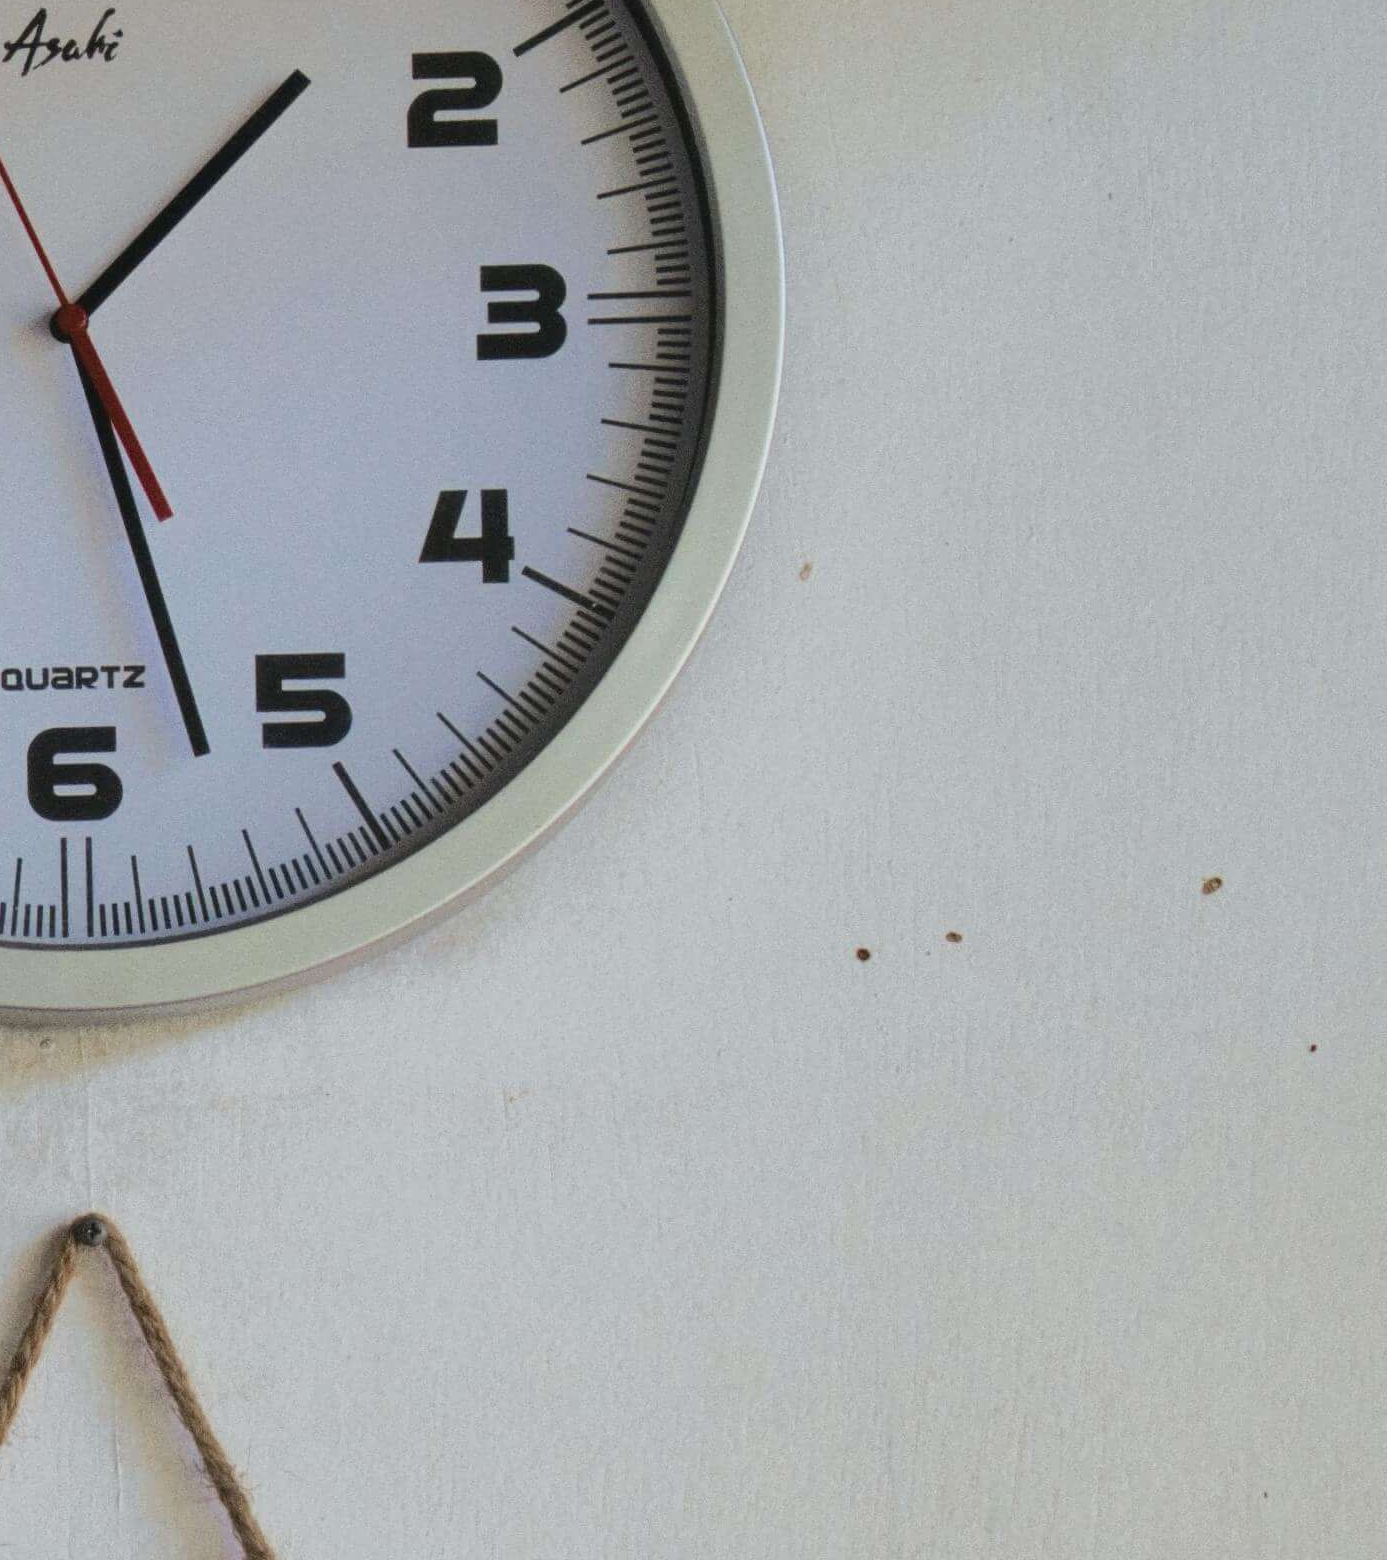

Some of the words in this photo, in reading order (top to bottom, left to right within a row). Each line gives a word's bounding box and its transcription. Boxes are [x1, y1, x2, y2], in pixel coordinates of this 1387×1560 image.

[2, 8, 123, 77] Asahi
[405, 51, 504, 148] 2
[474, 264, 568, 361] 3
[418, 488, 515, 584] 4
[254, 652, 352, 749] 5
[25, 726, 125, 822] 6
